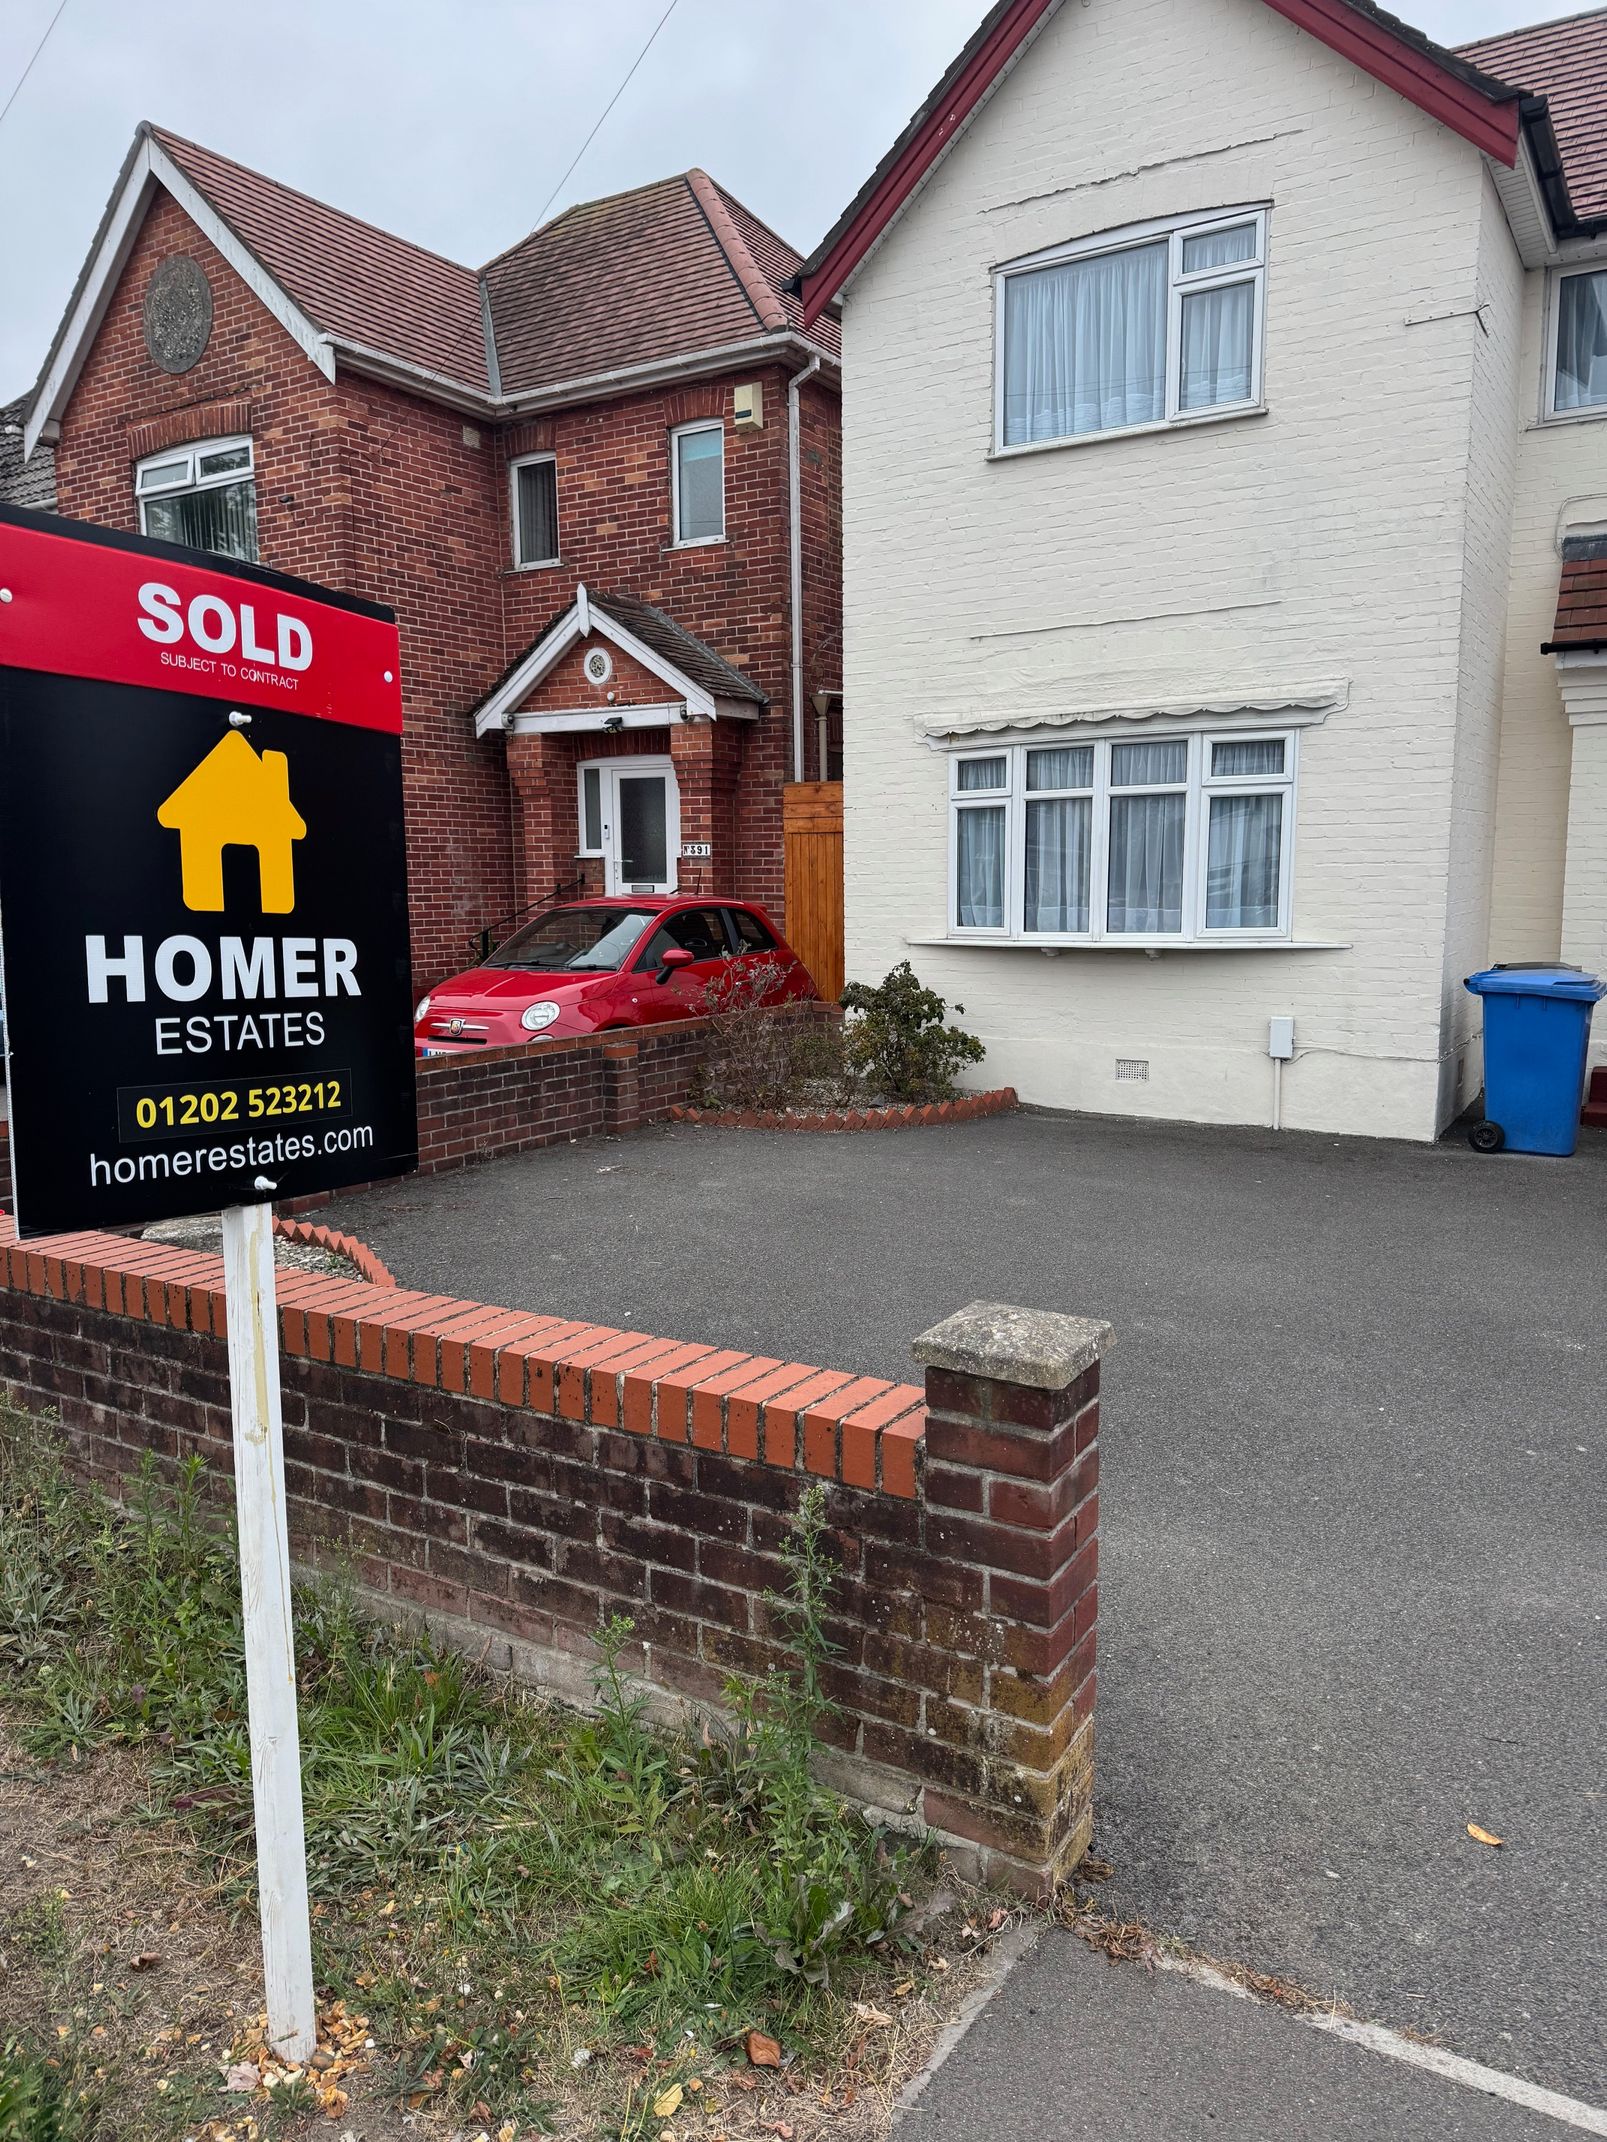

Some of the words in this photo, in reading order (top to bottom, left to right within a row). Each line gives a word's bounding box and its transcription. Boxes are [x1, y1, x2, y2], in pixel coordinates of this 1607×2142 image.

[137, 582, 313, 672] SOLD
[160, 652, 216, 673] SUBJECT
[220, 663, 237, 677] TO
[240, 668, 299, 690] CONTRACT
[85, 934, 362, 1003] HOMER
[155, 1011, 325, 1055] ESTATES
[136, 1091, 239, 1129] 01202
[248, 1080, 341, 1117] 523212
[90, 1125, 374, 1187] homerestates.com
